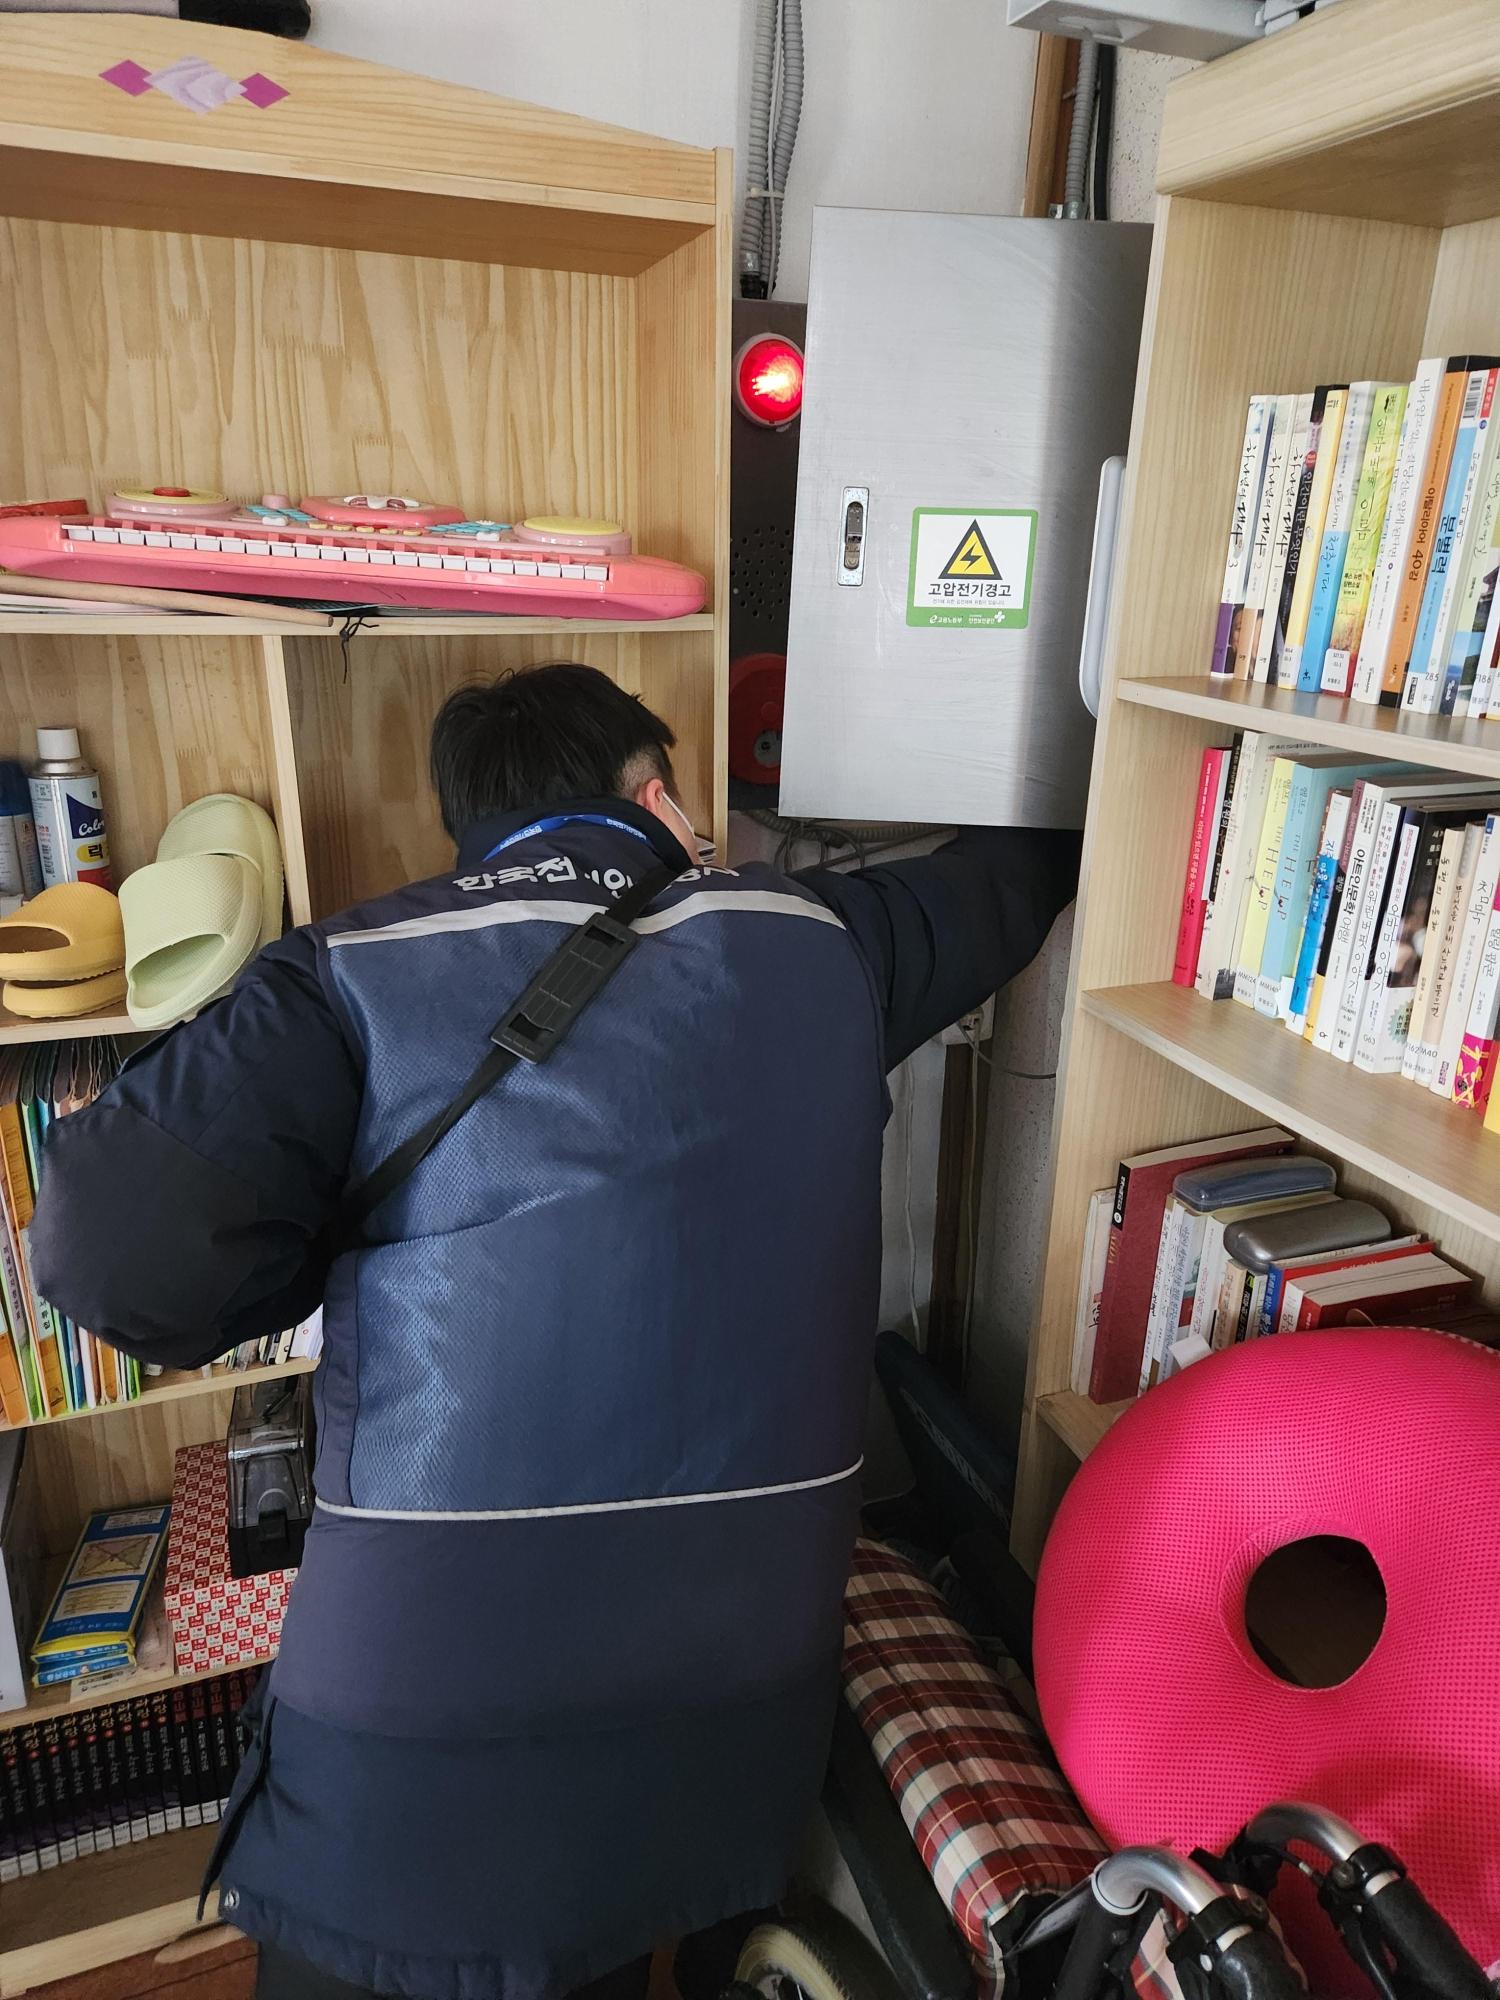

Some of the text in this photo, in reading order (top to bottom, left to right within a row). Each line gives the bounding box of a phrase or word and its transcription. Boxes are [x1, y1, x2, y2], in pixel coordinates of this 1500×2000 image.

[1296, 472, 1312, 520] 인간이란
[1356, 491, 1375, 541] 이름
[1230, 502, 1246, 545] 대사
[1255, 512, 1270, 556] 대사
[1276, 512, 1291, 556] 대사
[1409, 487, 1436, 581] 이탈리아어 40강
[1432, 515, 1456, 573] 분별력
[1228, 560, 1238, 568] 3
[1286, 526, 1304, 577] 무엇인가
[1320, 536, 1339, 592] 청춘이다
[928, 583, 1012, 598] 고압전기경고
[1258, 848, 1278, 910] HELP
[1278, 856, 1297, 920] HELP
[1338, 849, 1365, 944] 아트인문학 여행
[1470, 880, 1494, 924] 침묵
[1348, 953, 1365, 995] 이야기
[1372, 904, 1400, 998] 오바마 이야기
